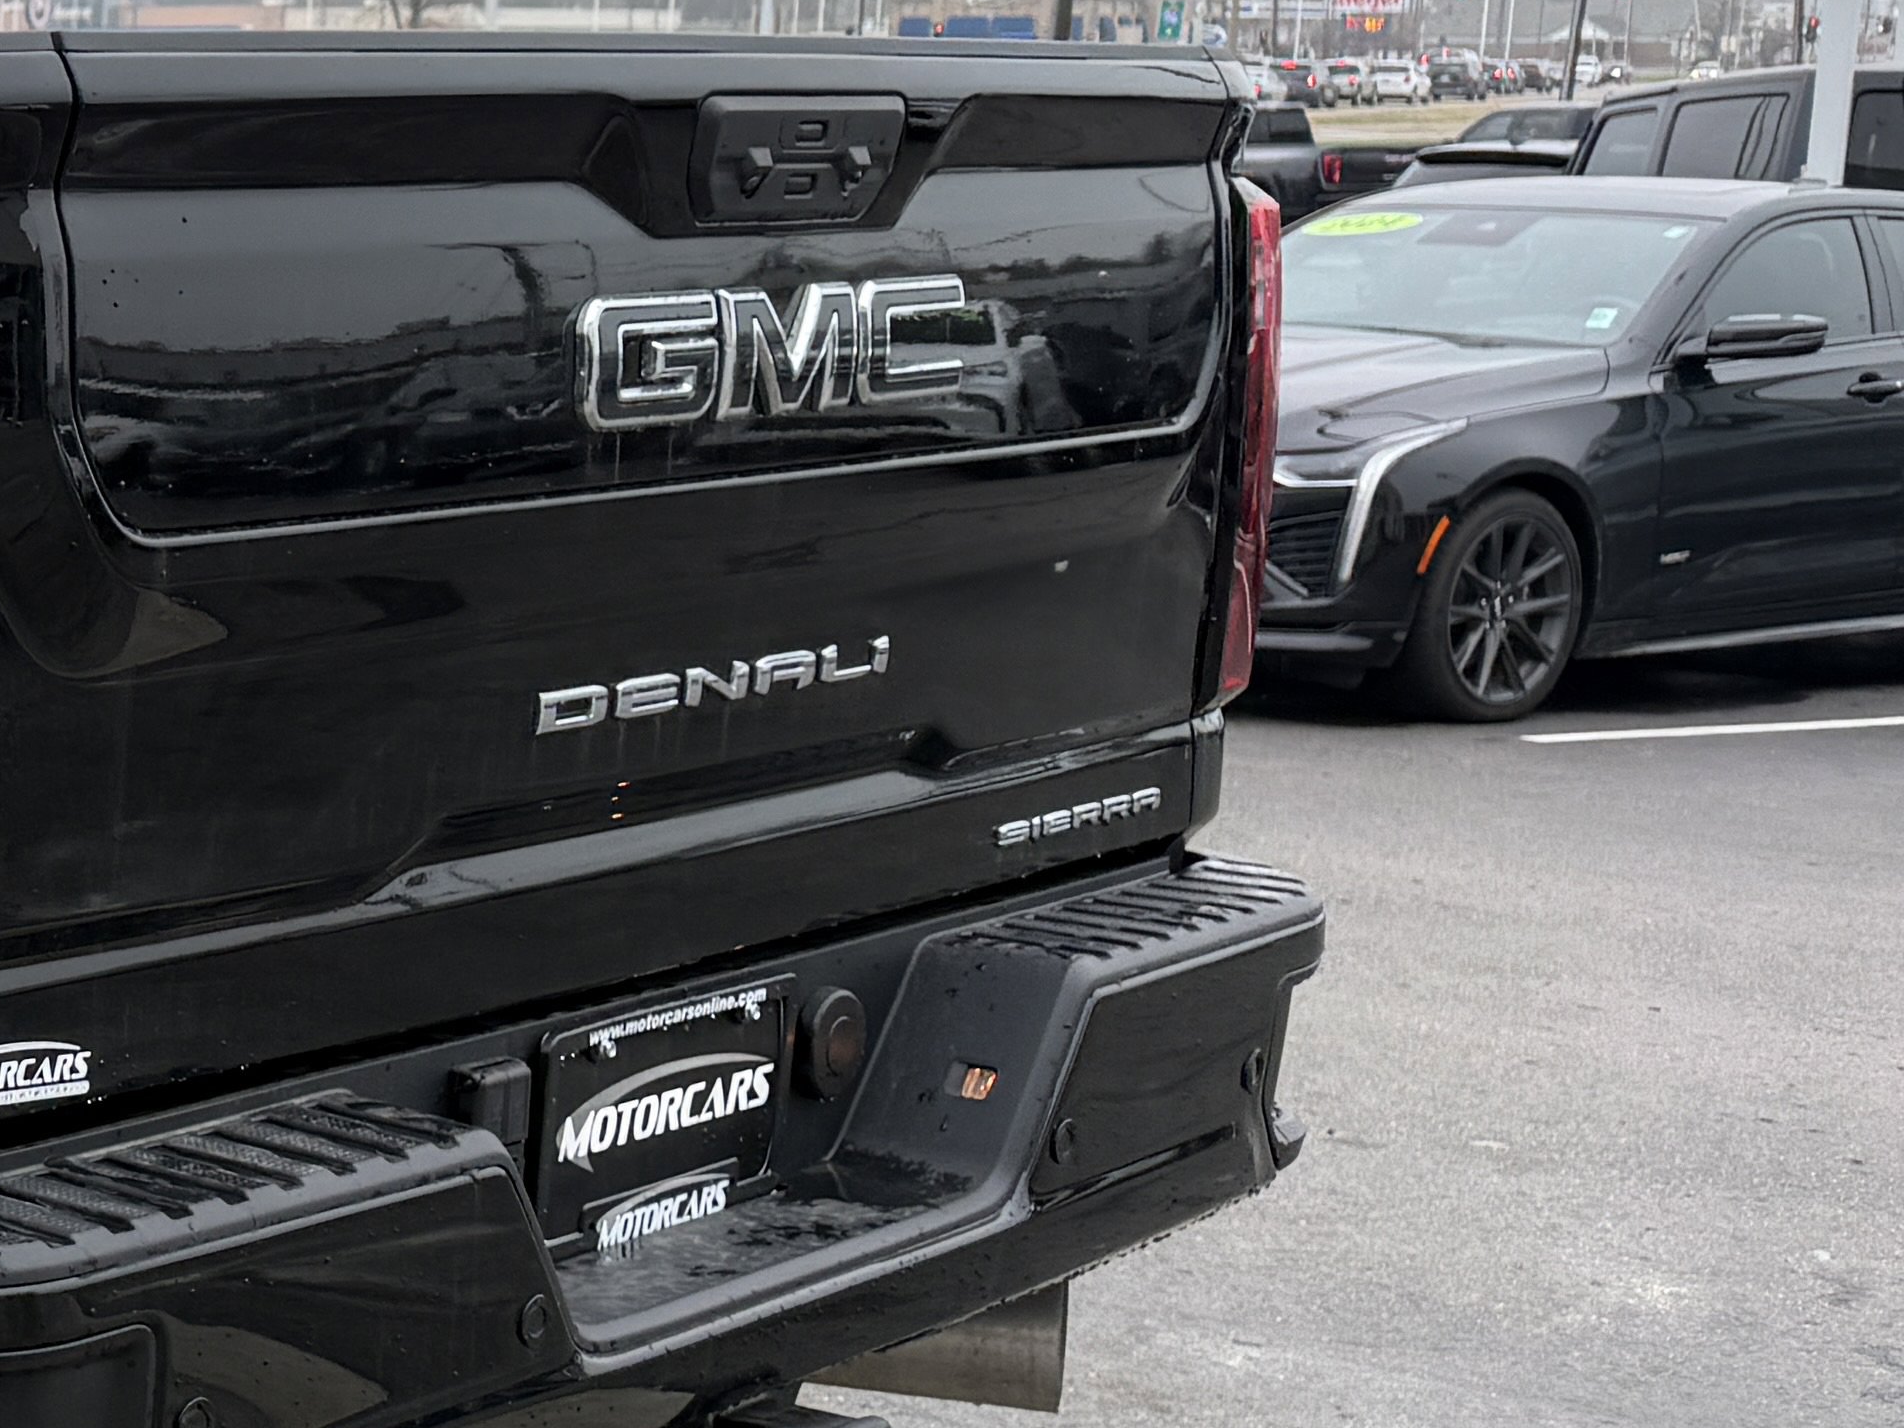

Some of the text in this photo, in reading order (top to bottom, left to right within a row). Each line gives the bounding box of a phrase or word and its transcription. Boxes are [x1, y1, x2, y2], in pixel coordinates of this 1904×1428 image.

[573, 273, 966, 432] GMC
[535, 634, 890, 736] DENALI
[997, 786, 1162, 846] SIERRA
[589, 987, 768, 1047] www.motorcarsonline.com
[558, 1062, 775, 1163] MOTORCARS
[597, 1179, 730, 1252] MOTORCARS
